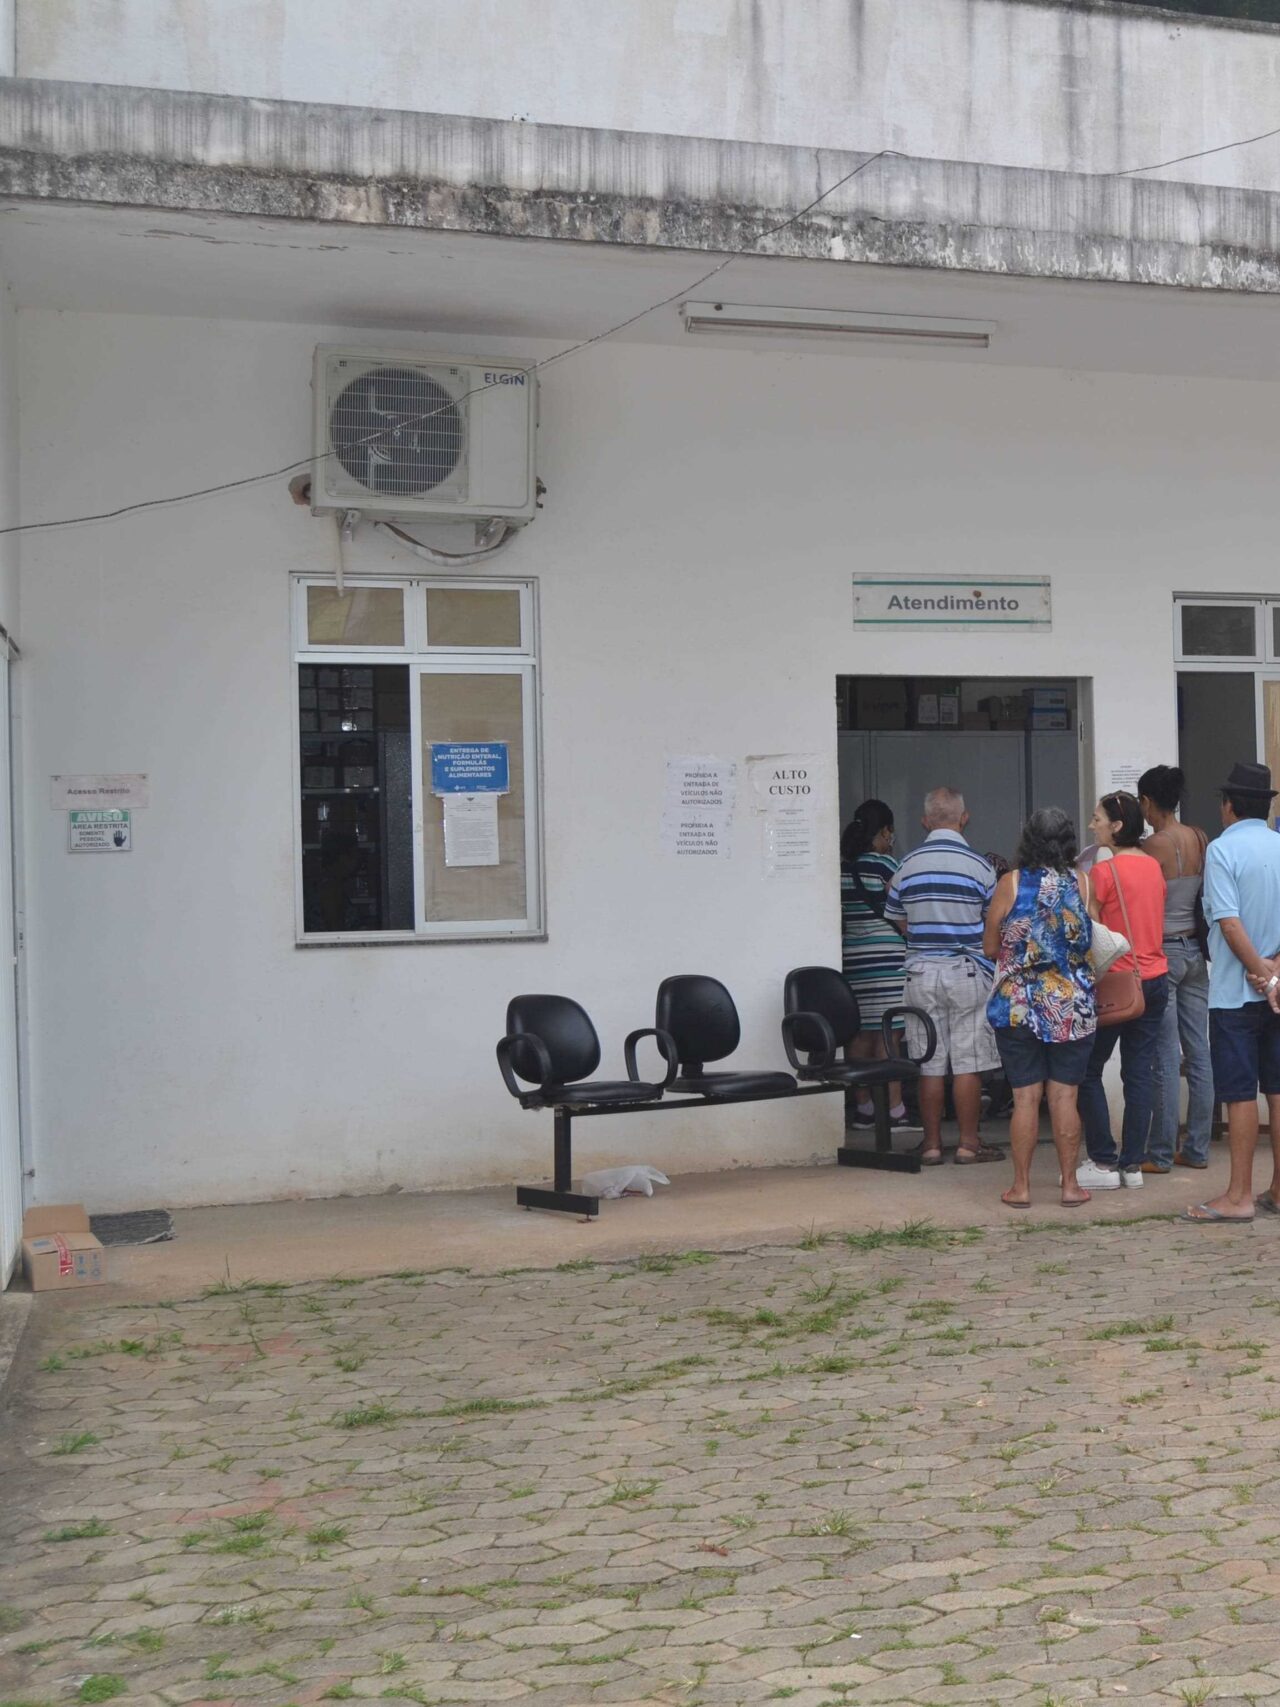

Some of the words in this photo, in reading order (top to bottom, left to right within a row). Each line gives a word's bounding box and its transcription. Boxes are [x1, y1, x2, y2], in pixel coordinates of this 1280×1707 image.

[484, 372, 525, 386] ELGIN
[887, 594, 1020, 612] Atendimento
[772, 769, 807, 780] ALTO
[768, 785, 811, 795] CUSTO
[76, 812, 124, 822] AVISO
